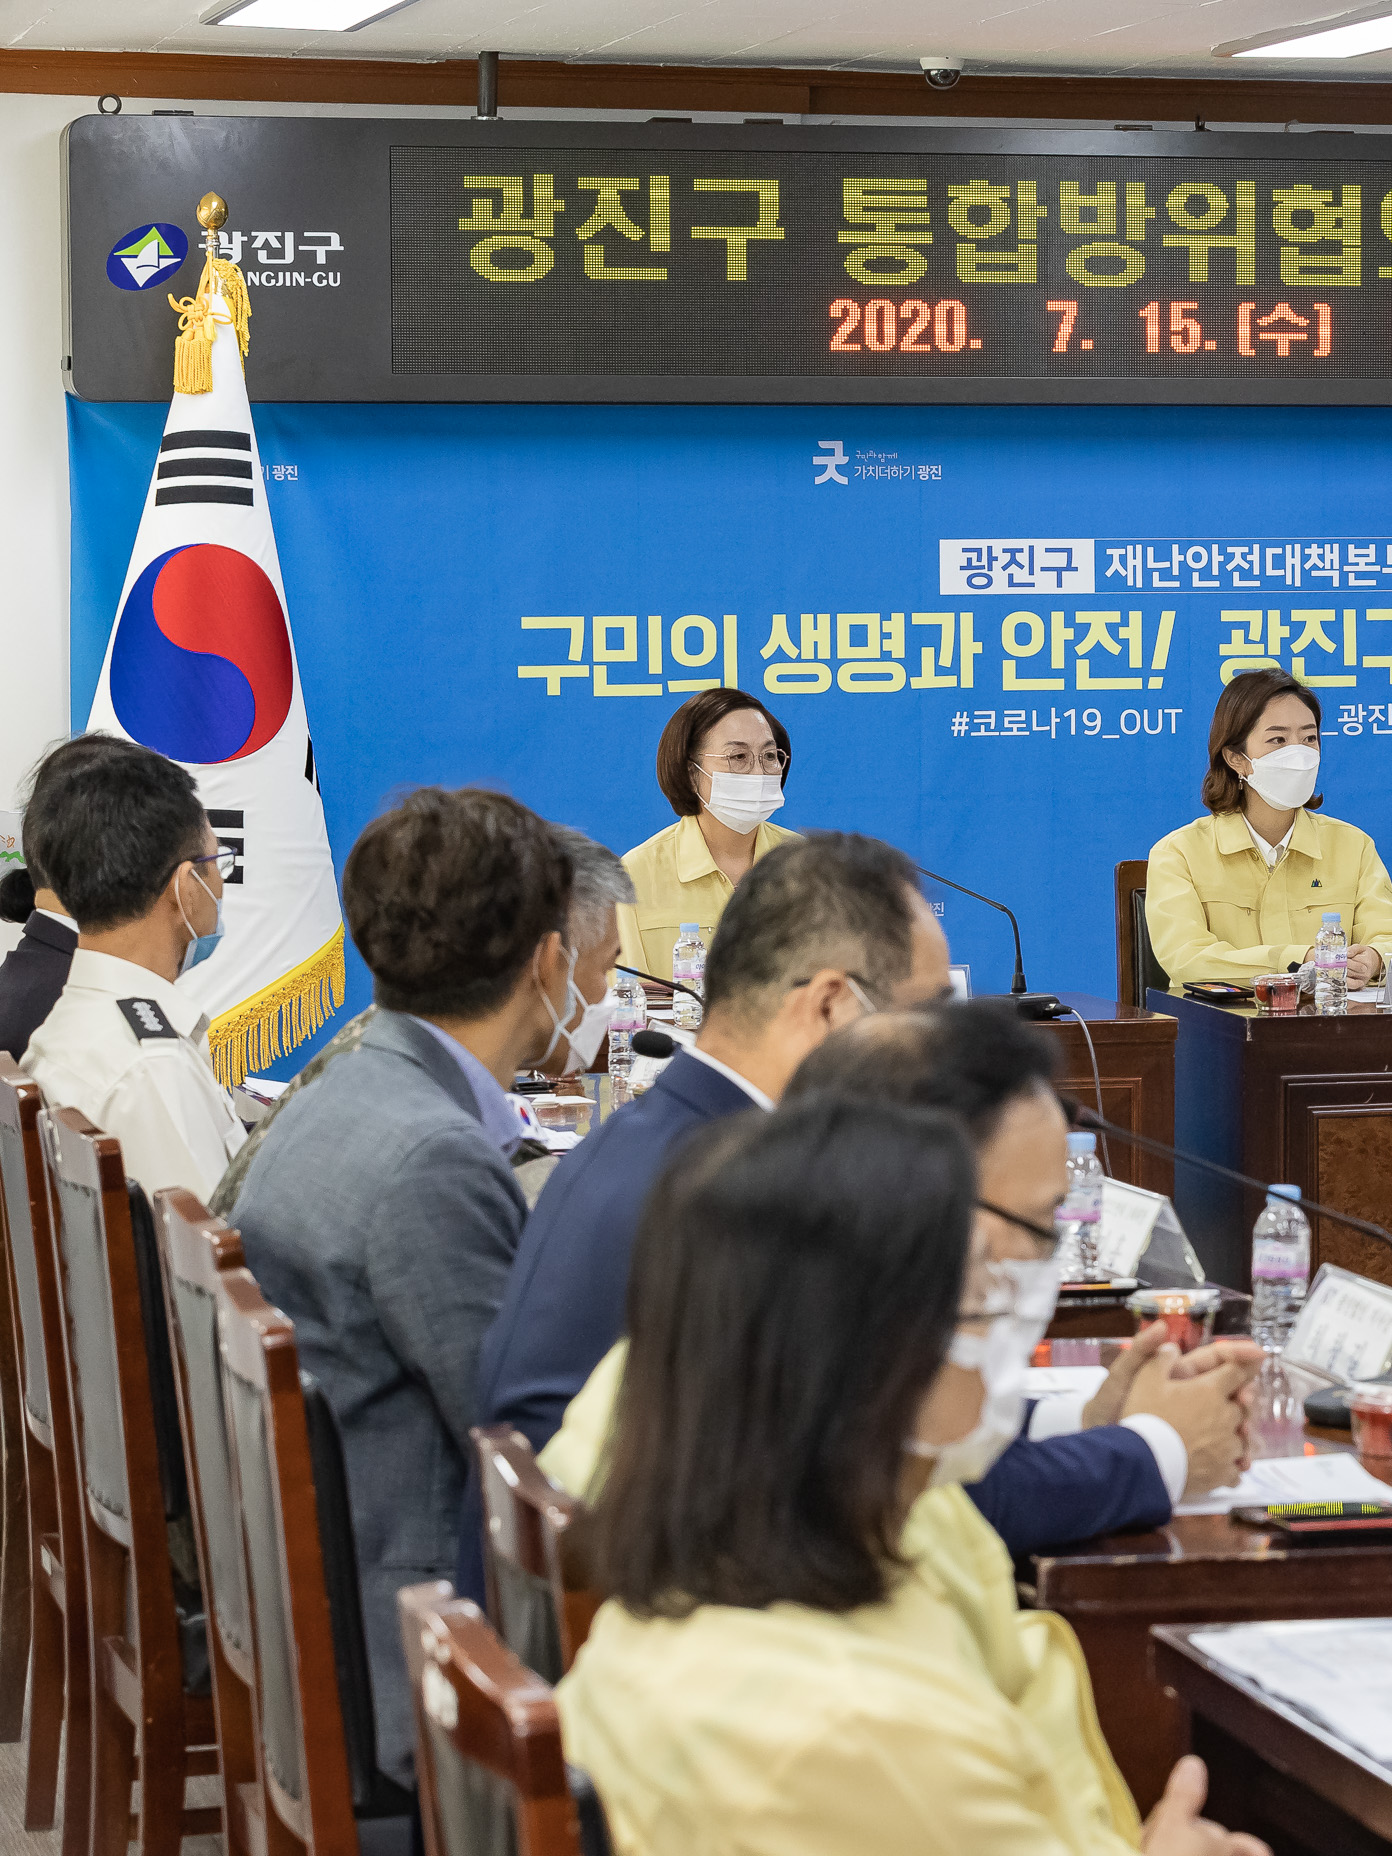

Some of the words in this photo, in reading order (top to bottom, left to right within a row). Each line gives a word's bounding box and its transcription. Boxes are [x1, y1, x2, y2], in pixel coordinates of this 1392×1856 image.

[458, 173, 785, 282] 광진구
[247, 272, 341, 287] NGJIN-GU
[828, 299, 983, 354] 2020.
[1046, 300, 1094, 354] 7.
[854, 465, 915, 481] 가치더하기
[917, 465, 942, 481] 광진
[959, 545, 1079, 590] 광진구
[517, 614, 738, 697] 구민의
[760, 612, 983, 694] 생명과
[1001, 610, 1177, 691] 안전!
[950, 707, 1183, 739] #코로나19_OUT
